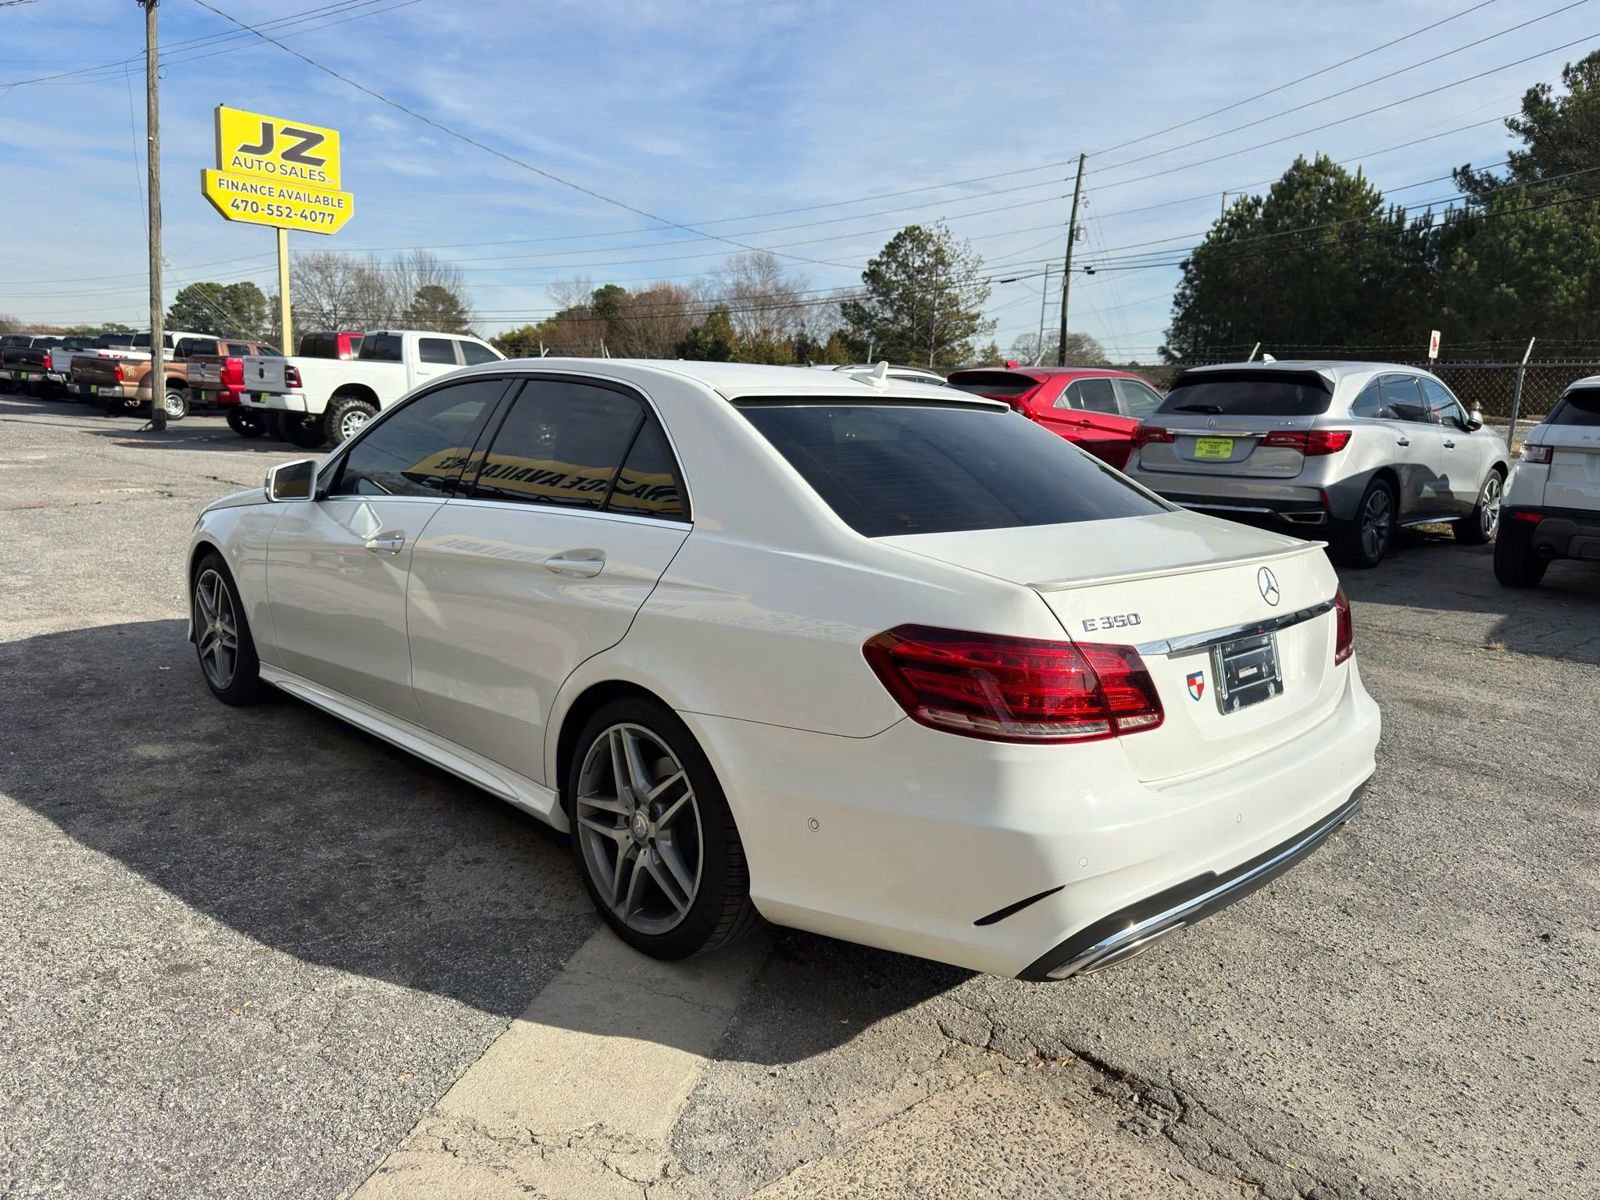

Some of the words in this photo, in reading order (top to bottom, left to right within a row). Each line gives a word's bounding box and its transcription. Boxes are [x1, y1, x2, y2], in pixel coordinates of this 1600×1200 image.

[237, 122, 327, 167] JZ
[232, 156, 276, 173] AUTO
[279, 164, 326, 182] SALES
[218, 178, 275, 197] FINANCE
[278, 189, 344, 208] AVAILABLE
[231, 198, 335, 225] 470-552-4077
[1082, 619, 1098, 632] E
[1099, 613, 1141, 629] 350
